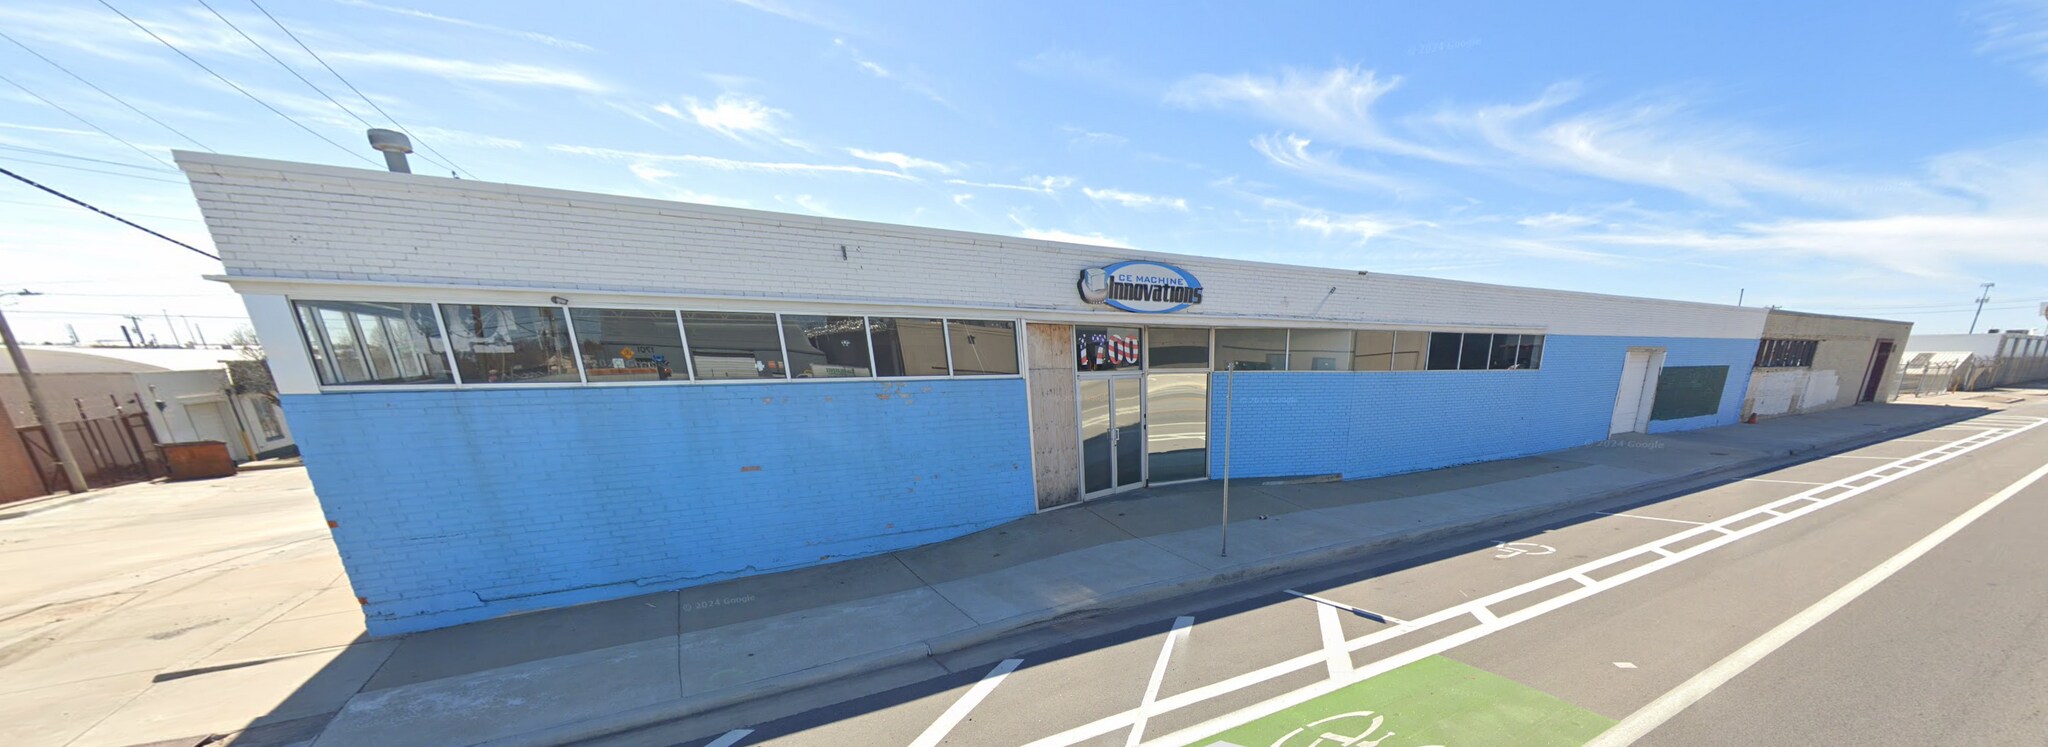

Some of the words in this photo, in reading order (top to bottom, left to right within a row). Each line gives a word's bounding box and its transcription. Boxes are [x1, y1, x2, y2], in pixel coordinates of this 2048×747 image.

[1108, 275, 1203, 304] Innovations
[1136, 275, 1183, 285] MACHINE
[1078, 333, 1138, 365] 1700
